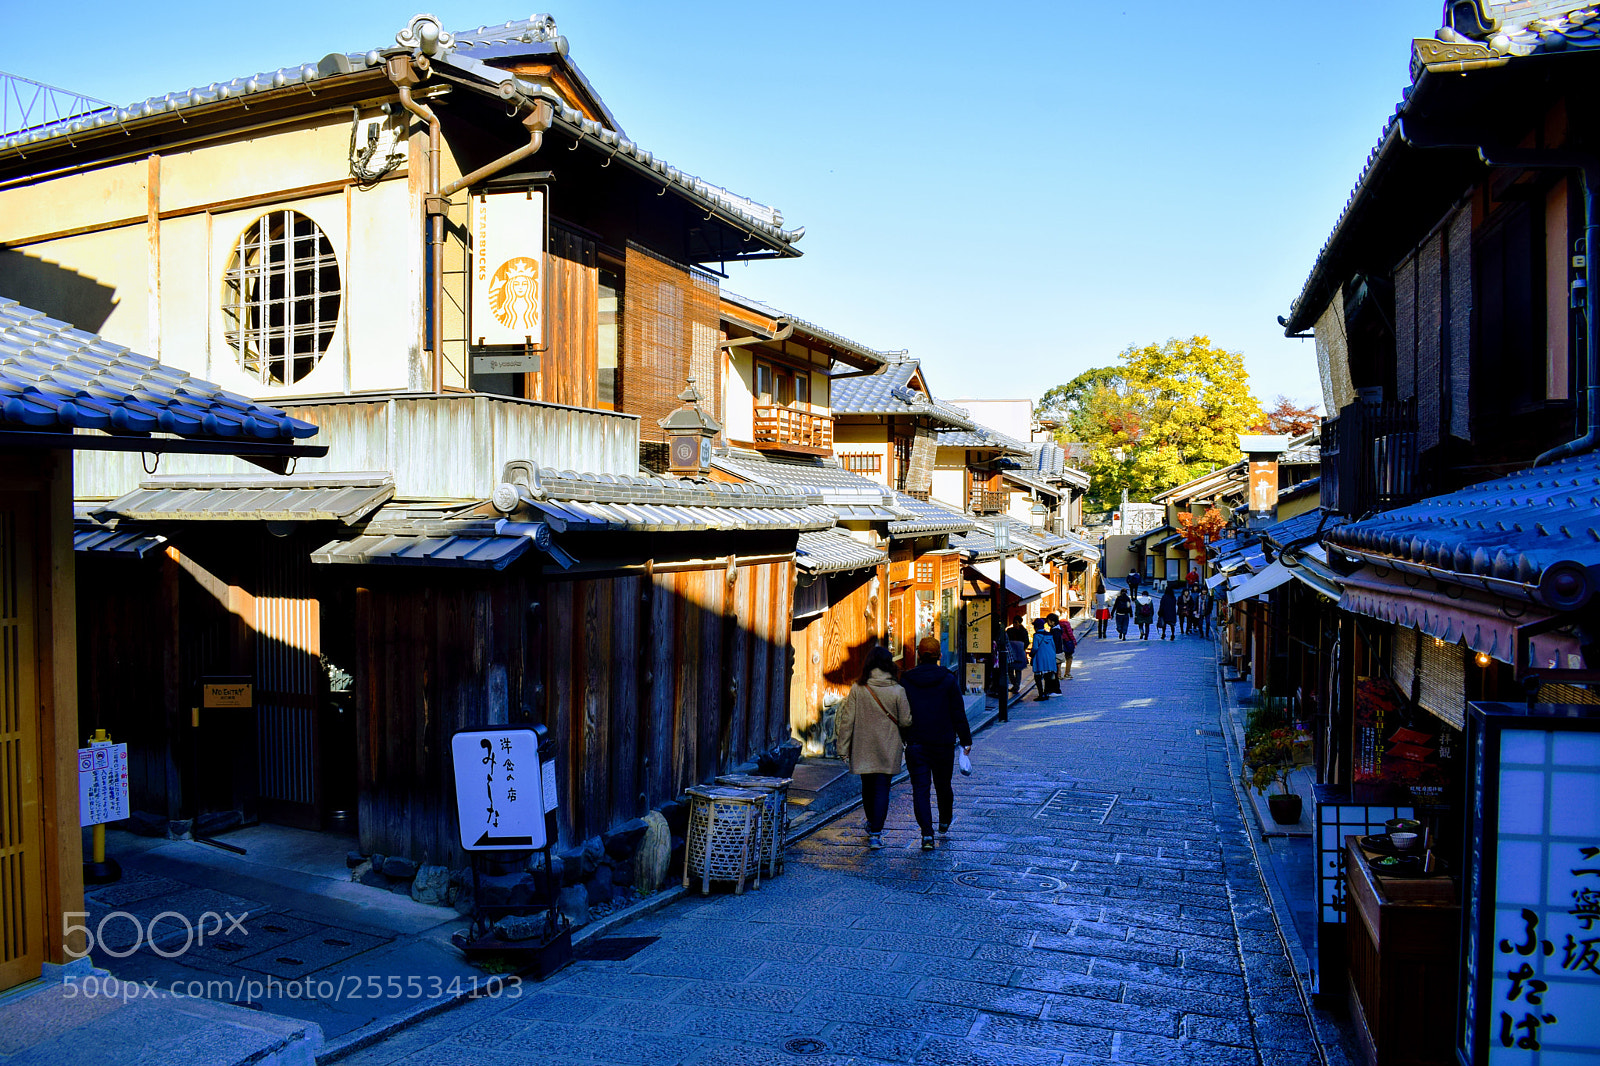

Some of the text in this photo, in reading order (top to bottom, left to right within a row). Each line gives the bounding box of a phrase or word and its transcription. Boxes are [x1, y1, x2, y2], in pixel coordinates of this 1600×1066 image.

[501, 738, 517, 802] 洋食の店
[1562, 846, 1600, 975] 二寧坂
[1500, 908, 1556, 1051] ふたば
